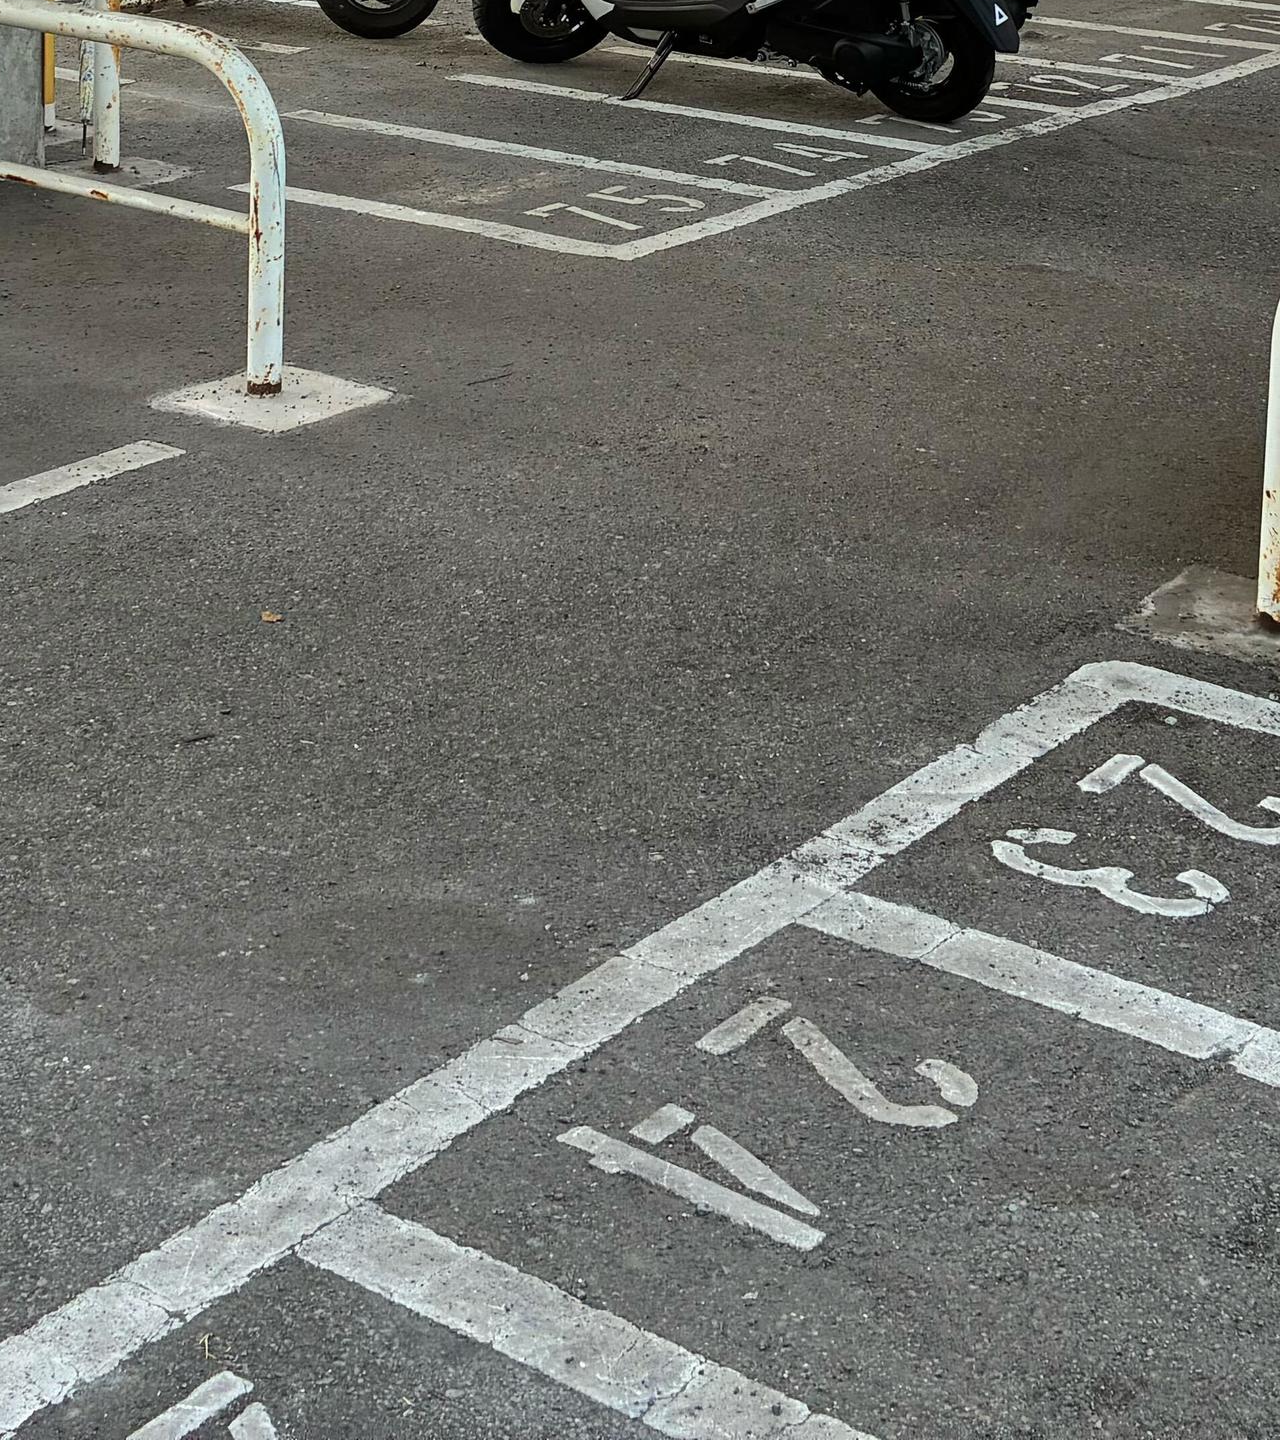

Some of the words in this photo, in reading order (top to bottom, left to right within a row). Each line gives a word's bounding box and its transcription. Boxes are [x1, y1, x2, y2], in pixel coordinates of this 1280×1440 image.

[1098, 44, 1229, 69] 71
[703, 142, 869, 177] 74
[523, 185, 707, 231] 75
[555, 996, 980, 1251] 24
